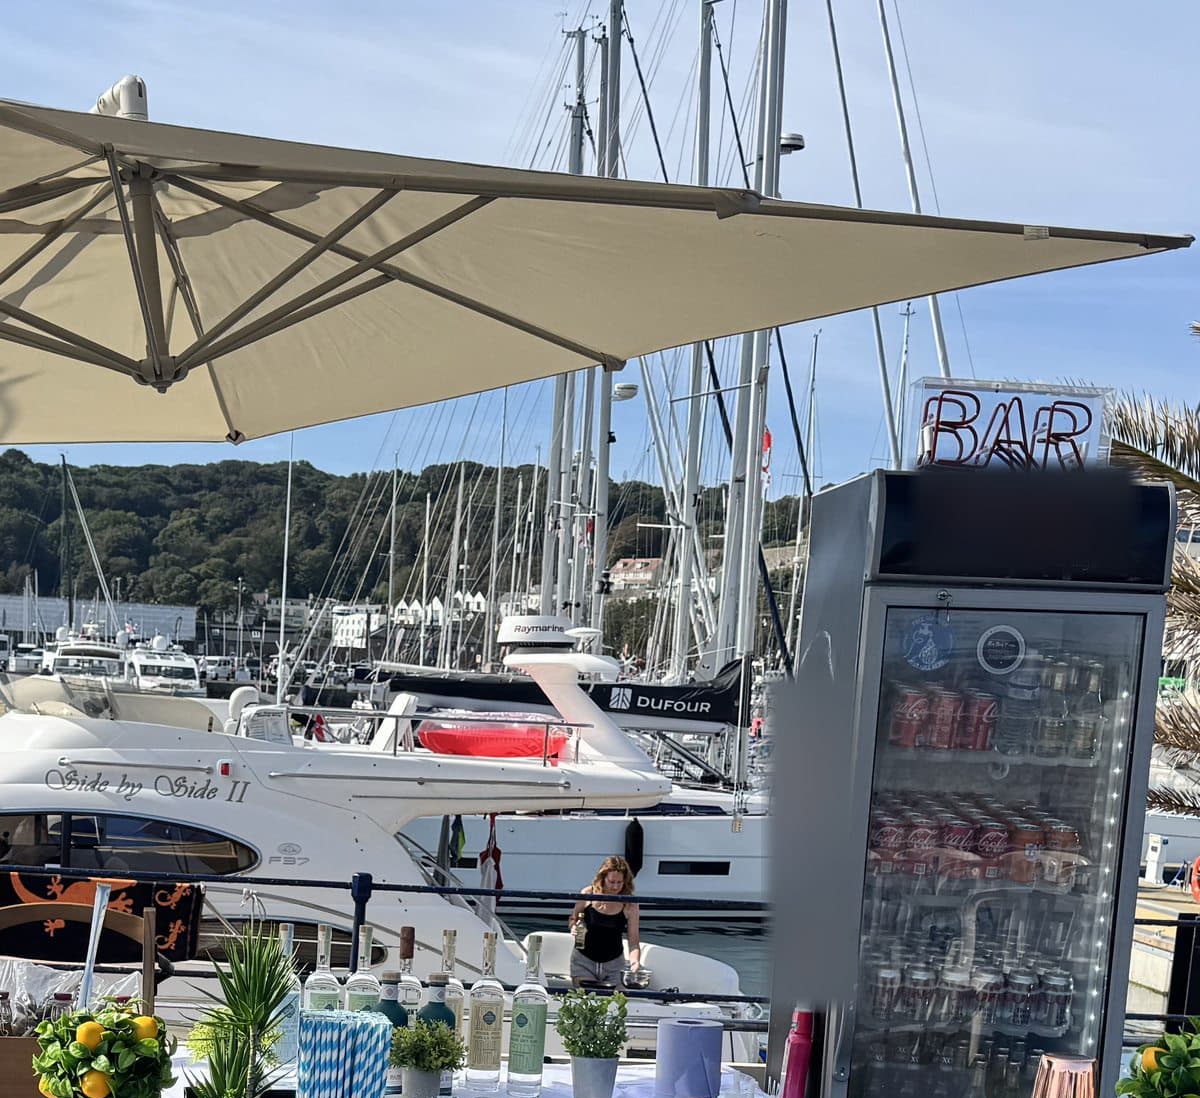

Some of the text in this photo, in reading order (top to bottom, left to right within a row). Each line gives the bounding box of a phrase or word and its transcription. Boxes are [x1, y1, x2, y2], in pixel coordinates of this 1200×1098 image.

[920, 390, 1092, 474] BAR
[514, 624, 565, 635] Raymarine
[636, 695, 712, 714] DUFOUR
[45, 769, 251, 803] Side by Side II
